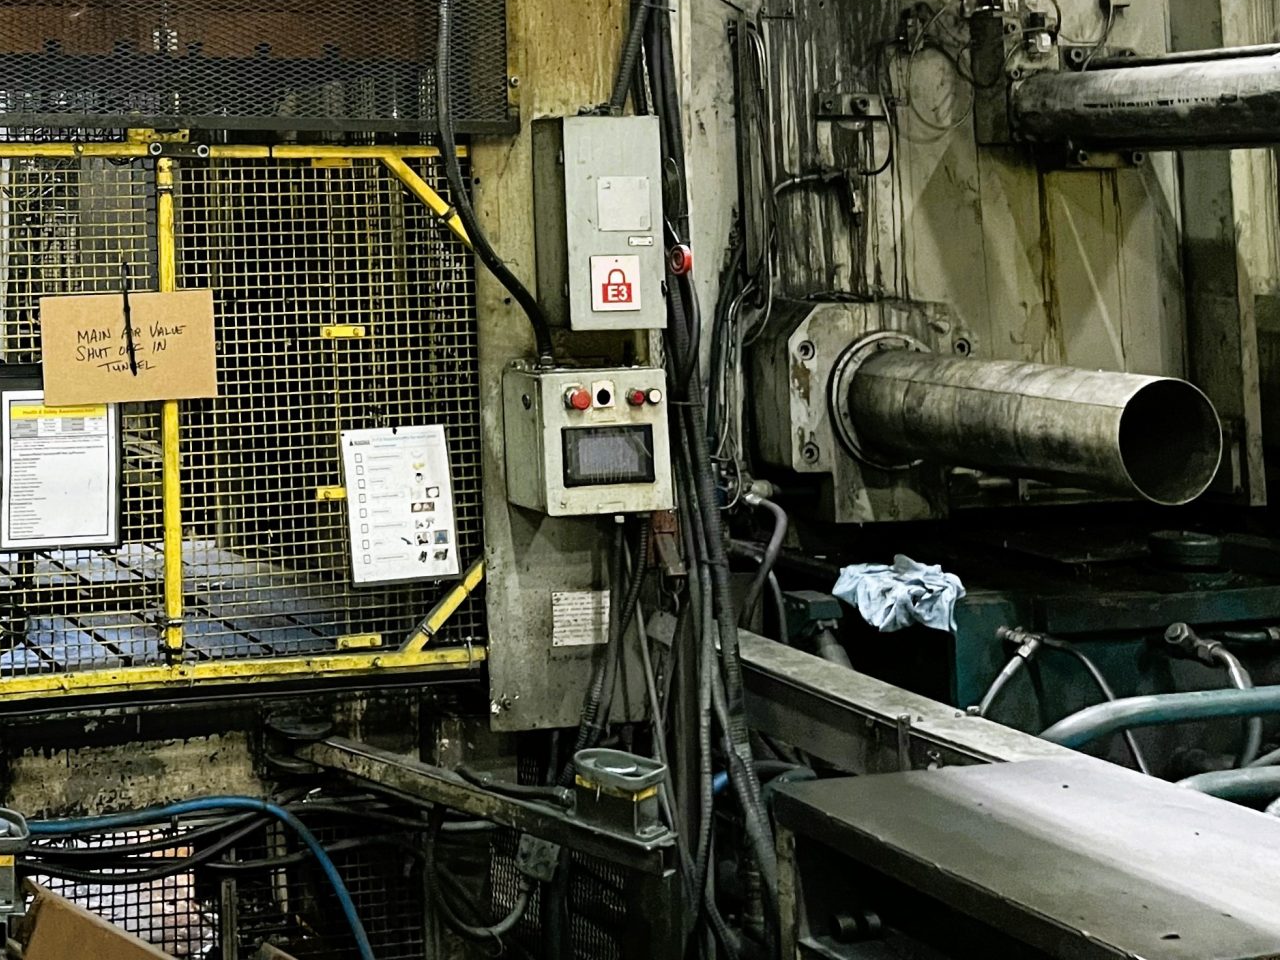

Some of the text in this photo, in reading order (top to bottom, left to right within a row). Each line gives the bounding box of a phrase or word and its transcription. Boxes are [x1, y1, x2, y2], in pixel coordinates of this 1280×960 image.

[607, 285, 628, 301] E3
[77, 328, 111, 344] MAIN
[121, 327, 141, 339] AR
[76, 345, 111, 362] SHUT
[152, 339, 167, 354] IN
[96, 360, 156, 373] TUNEL
